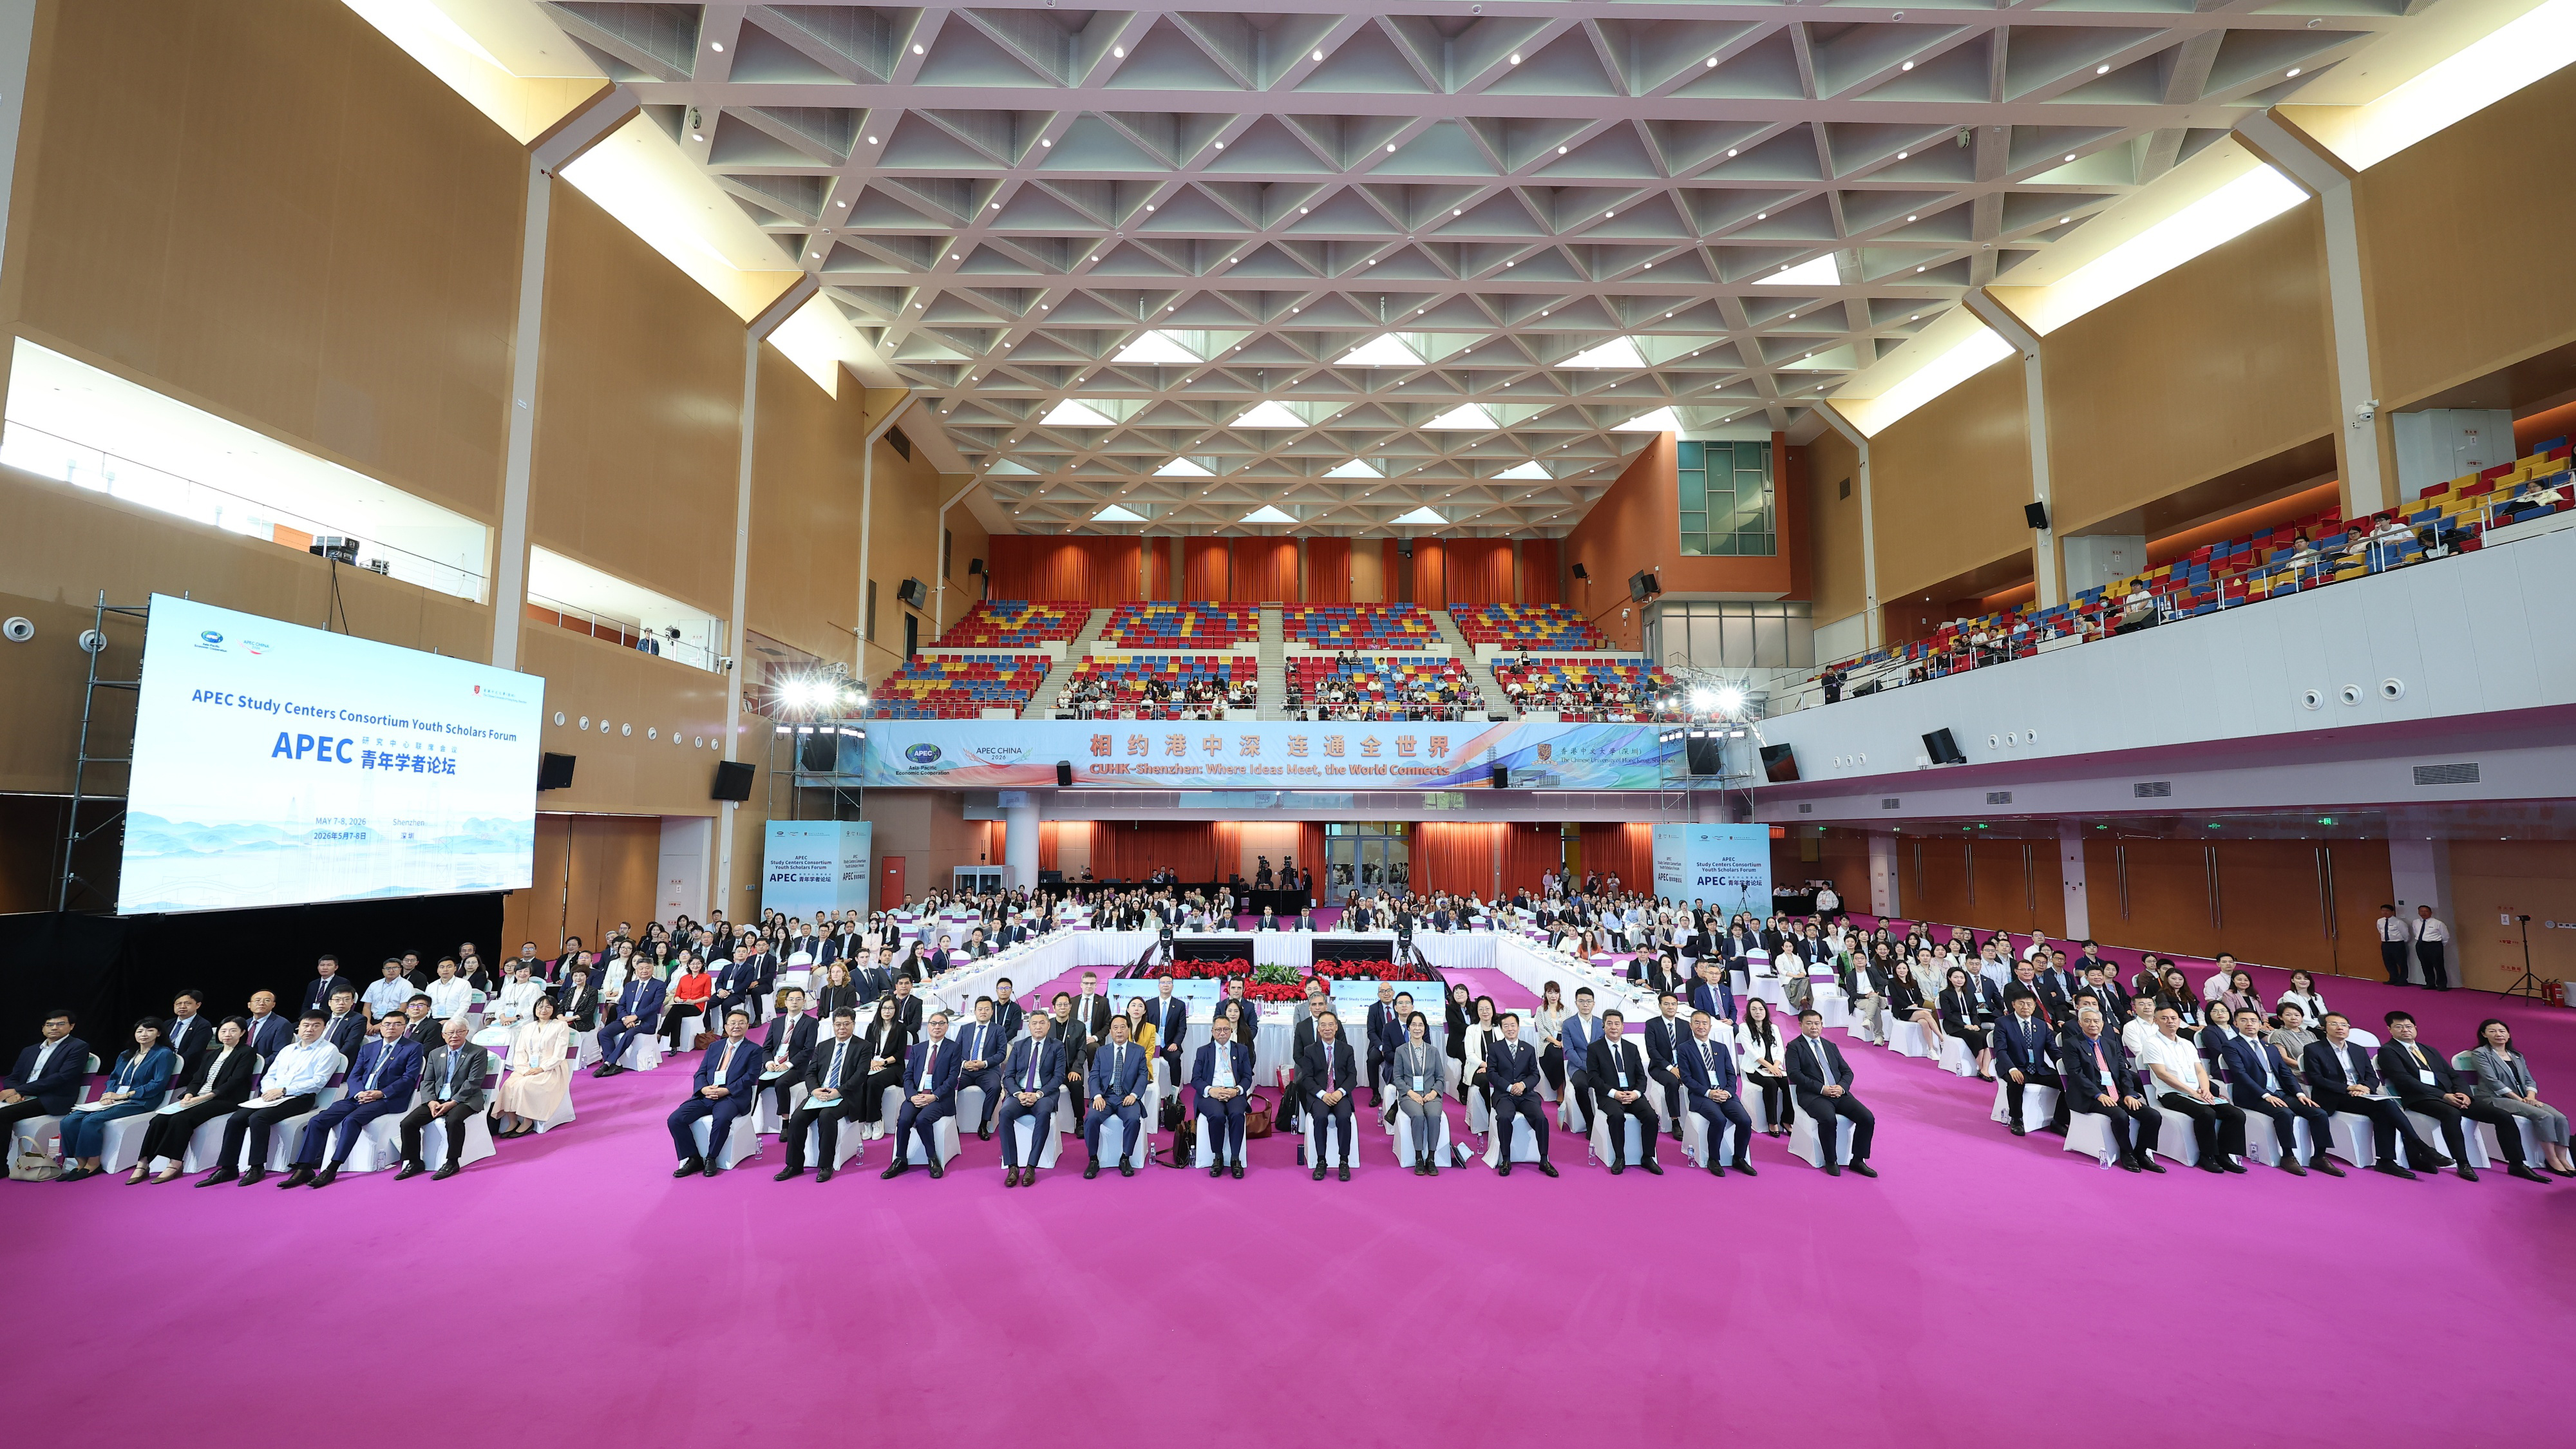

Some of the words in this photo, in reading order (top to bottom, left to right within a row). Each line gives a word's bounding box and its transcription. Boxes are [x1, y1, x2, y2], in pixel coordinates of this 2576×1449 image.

[192, 689, 234, 706] APEC
[238, 696, 280, 715] Study
[285, 702, 336, 719] Centers
[339, 710, 409, 728] Consortium
[412, 719, 442, 732] Youth
[446, 724, 486, 738] Scholars
[489, 730, 516, 742] Forum
[271, 732, 354, 764] APEC
[362, 736, 457, 753] 研究中心联席会议
[1090, 734, 1260, 757] 相约港中深
[1287, 734, 1450, 758] 连通全世界
[361, 750, 456, 775] 青年学者论坛
[1206, 763, 1246, 775] Where
[1250, 763, 1283, 775] Ideas
[1287, 764, 1321, 777] Meet,
[1325, 764, 1347, 775] the
[1349, 764, 1387, 775] World
[1390, 765, 1450, 776] Connects
[334, 817, 347, 826] 7-8,
[770, 873, 797, 882] APEC
[842, 872, 853, 881] APEC
[1658, 873, 1669, 882] APEC
[1697, 876, 1726, 886] APEC
